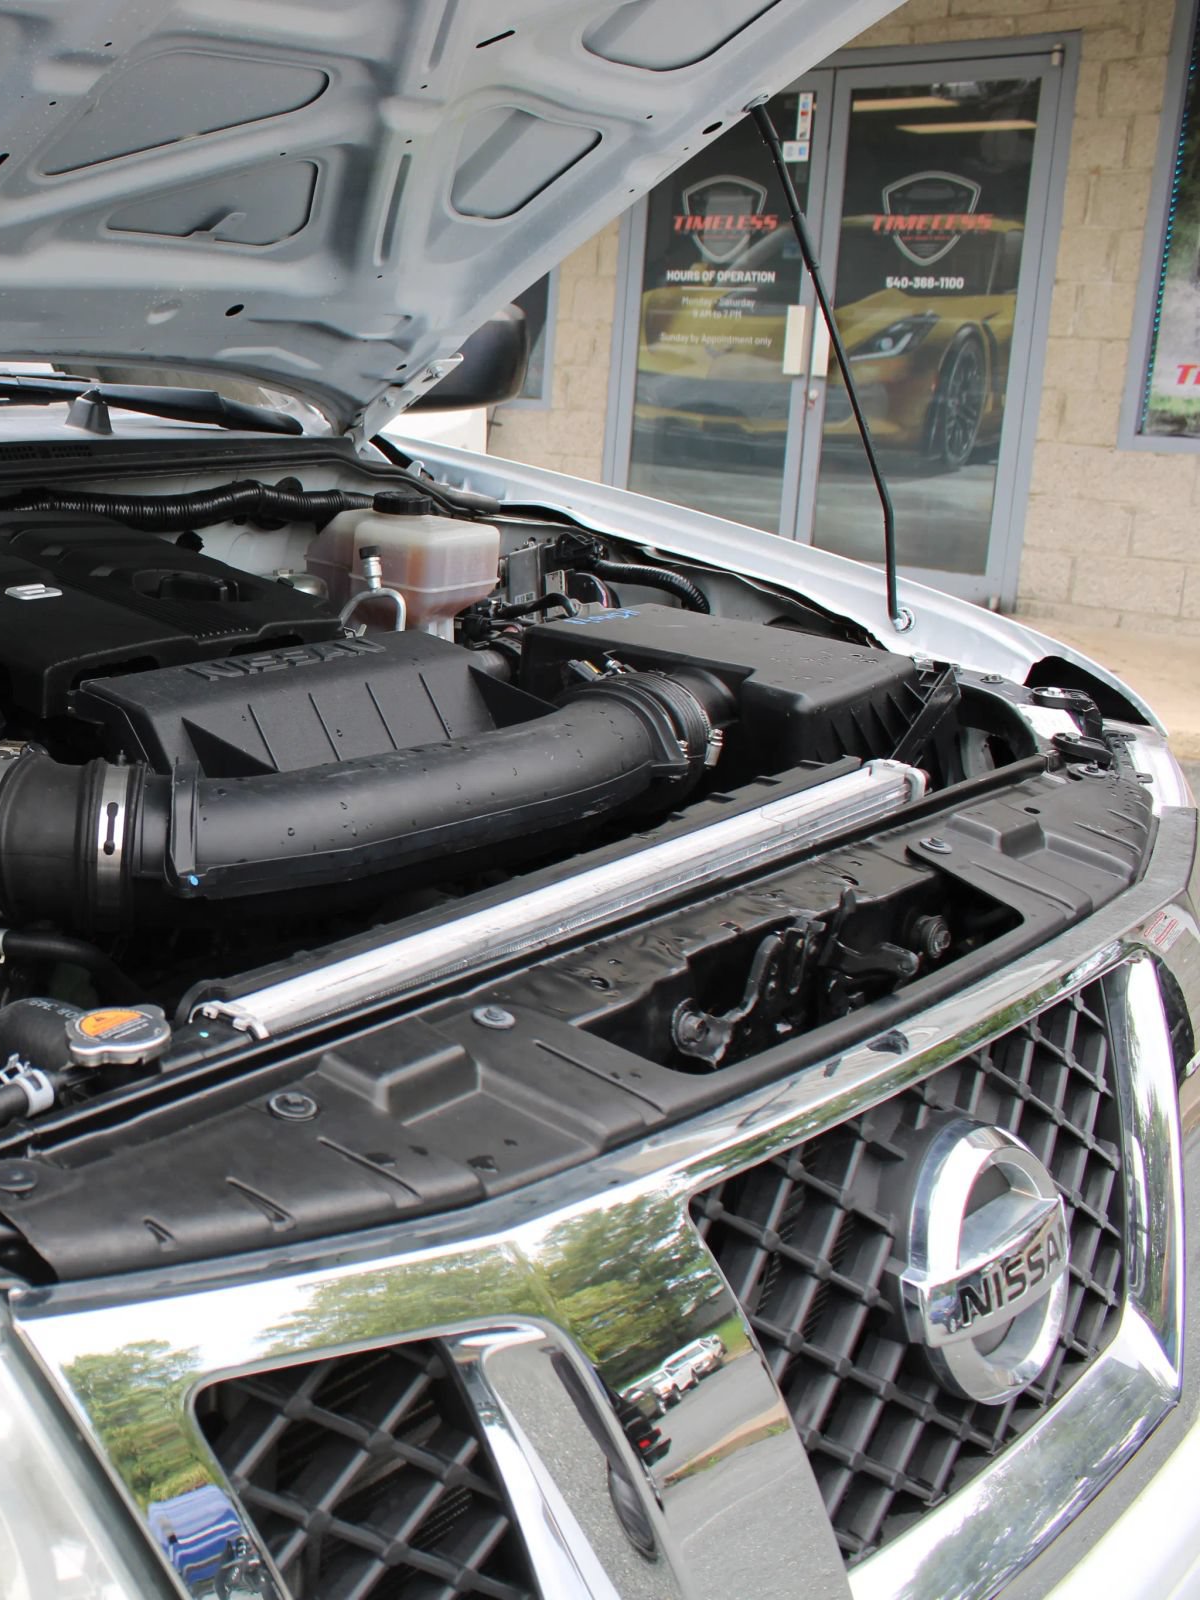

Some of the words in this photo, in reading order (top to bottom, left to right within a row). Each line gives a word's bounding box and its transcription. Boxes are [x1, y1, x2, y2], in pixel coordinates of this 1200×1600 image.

[673, 214, 779, 231] TIMELESS
[872, 213, 993, 231] TIMELESS
[666, 269, 700, 282] HOURS
[702, 270, 715, 282] OF
[717, 270, 776, 283] OPERATION
[719, 297, 756, 311] Saturday
[661, 332, 689, 344] Sunday
[691, 333, 699, 344] by
[702, 334, 753, 346] Appointment
[755, 336, 773, 347] only
[184, 637, 386, 682] NISSAN
